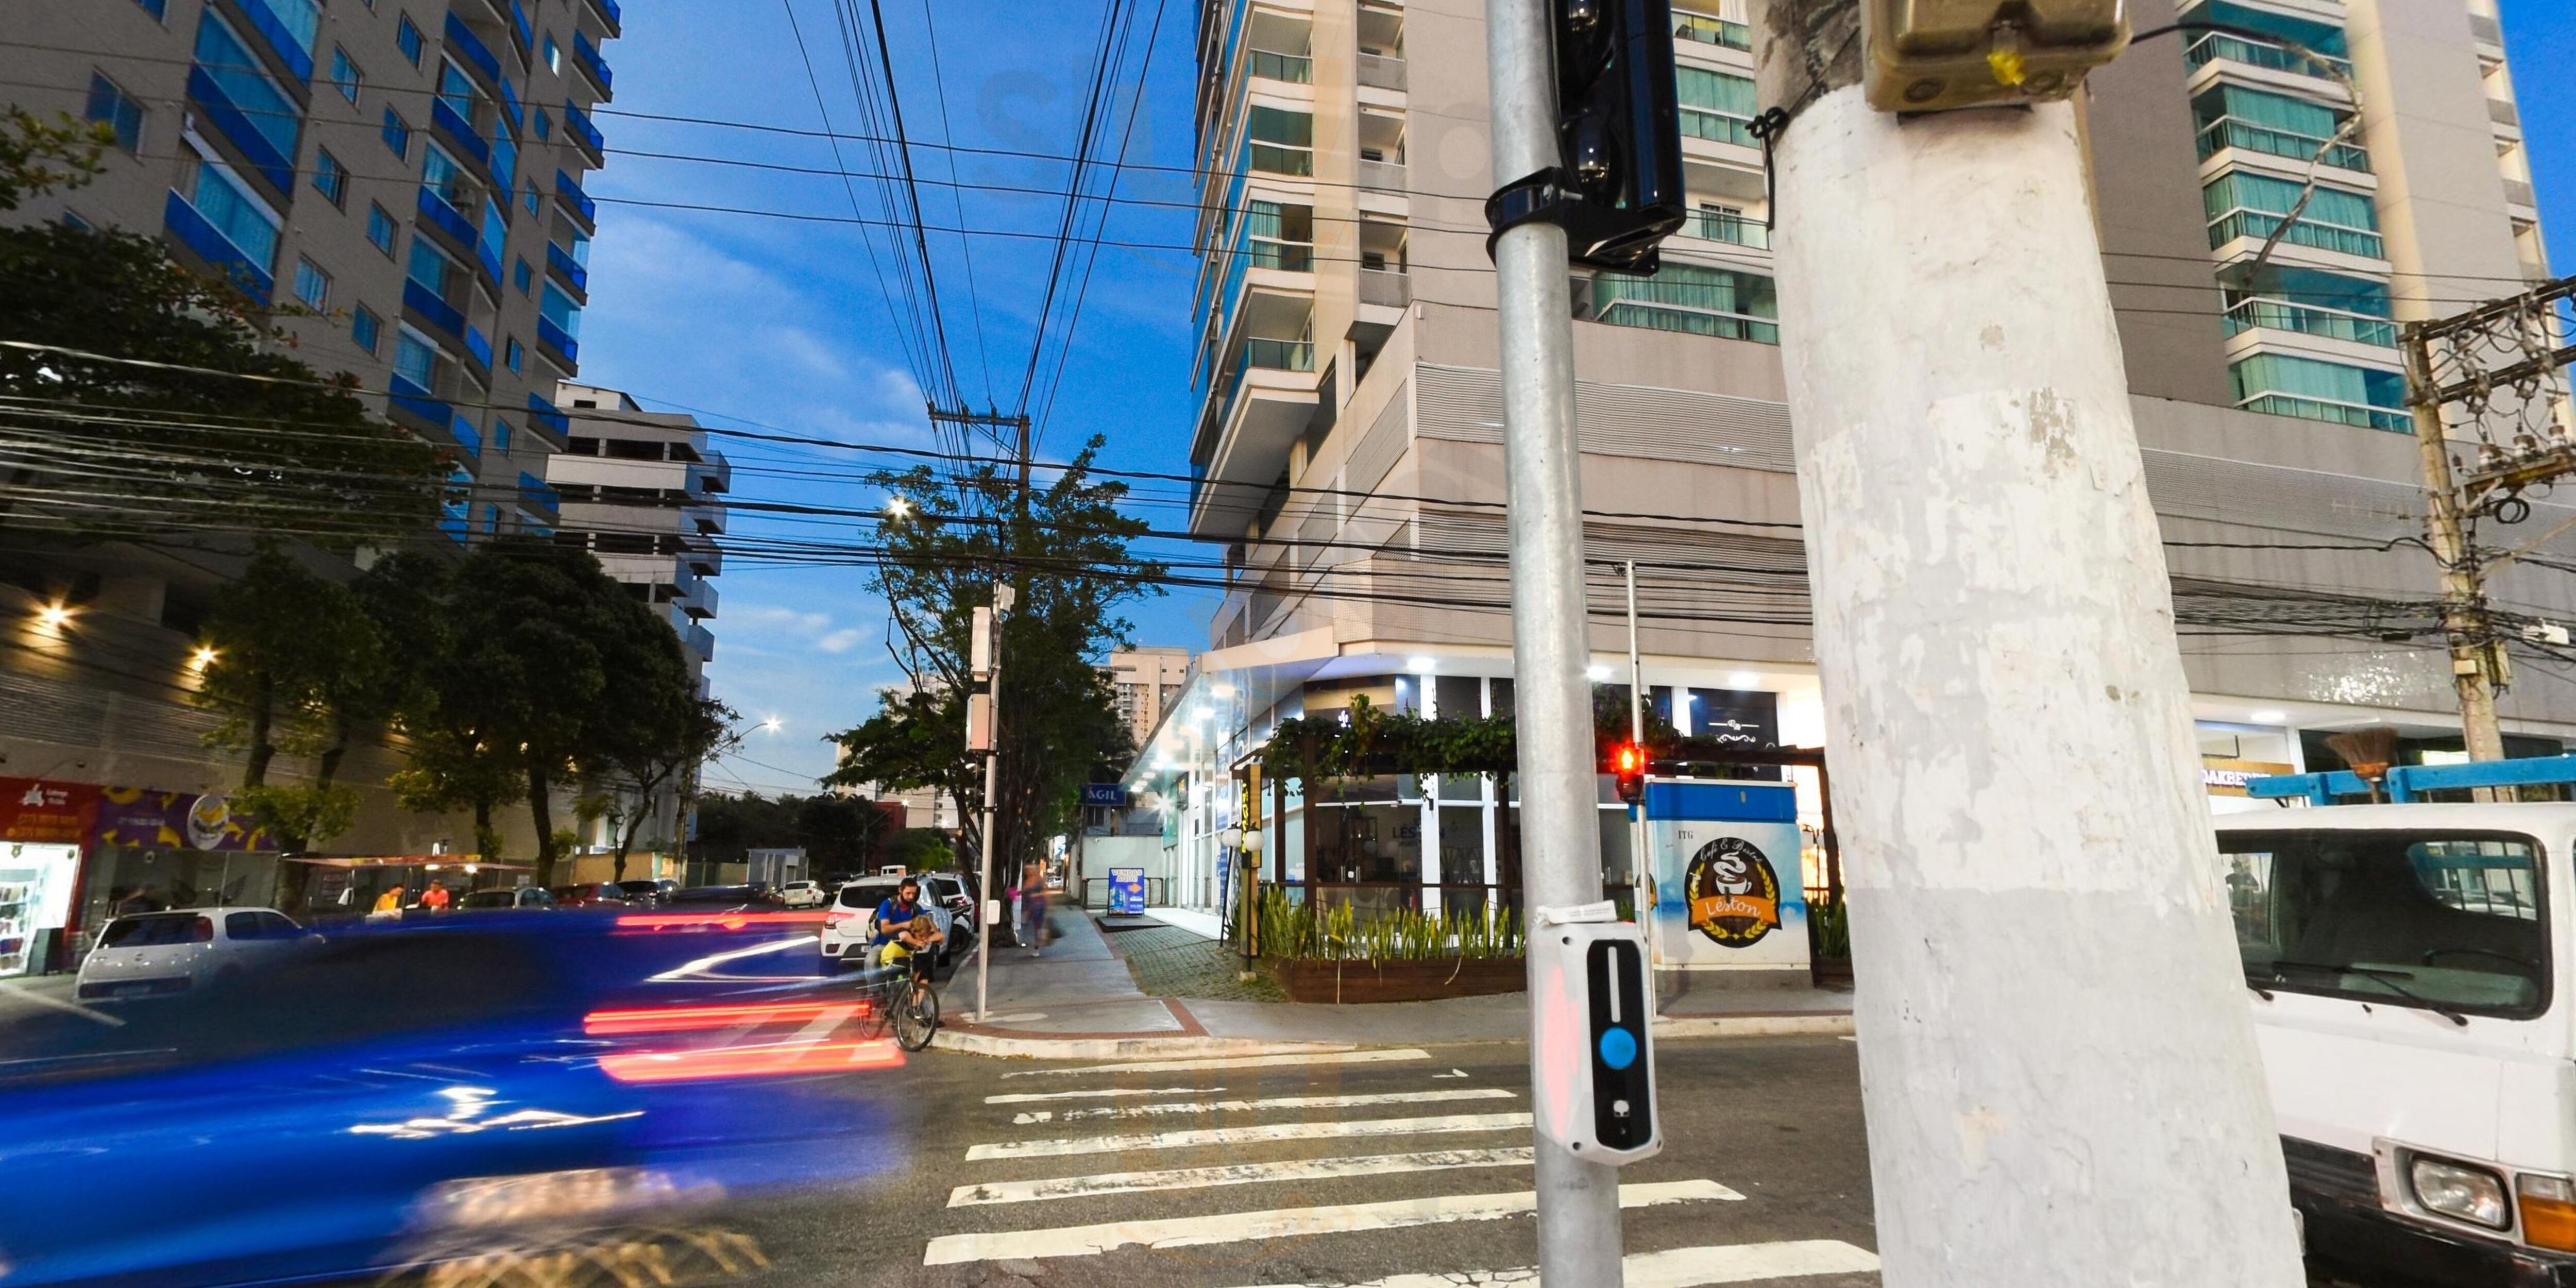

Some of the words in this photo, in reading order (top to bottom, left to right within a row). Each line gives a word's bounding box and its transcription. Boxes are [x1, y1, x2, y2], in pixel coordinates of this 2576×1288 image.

[1089, 787, 1116, 800] ÁGIL
[1678, 831, 1693, 839] ITG
[1705, 897, 1761, 916] Léston
